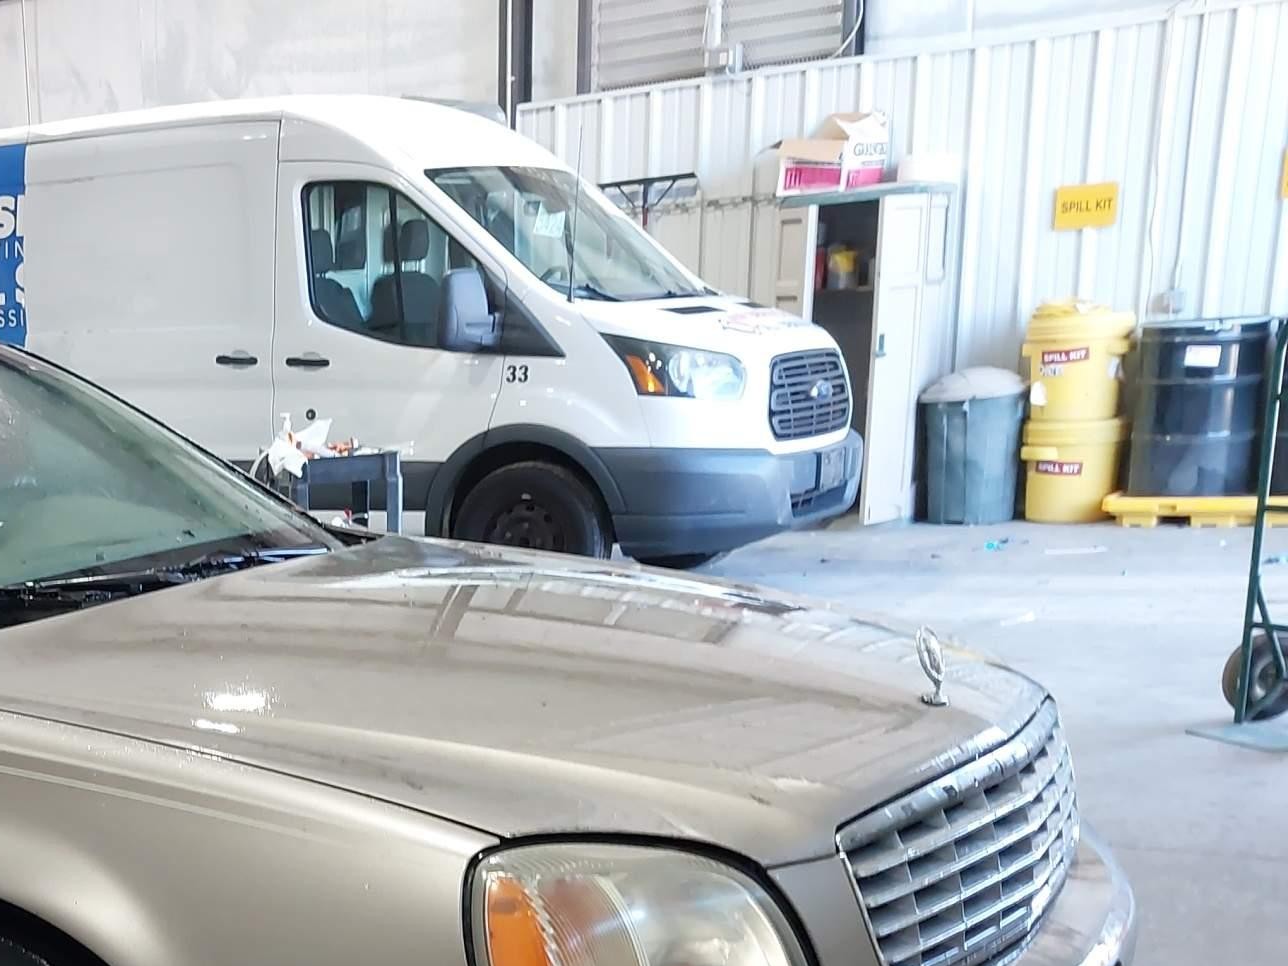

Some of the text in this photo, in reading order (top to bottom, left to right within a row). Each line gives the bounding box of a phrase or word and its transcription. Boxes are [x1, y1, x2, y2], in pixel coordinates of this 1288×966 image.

[1061, 197, 1114, 214] SPILL KIT
[1043, 350, 1087, 363] SPILL KIT
[506, 364, 529, 383] 33
[1038, 462, 1080, 474] SPILL KIT
